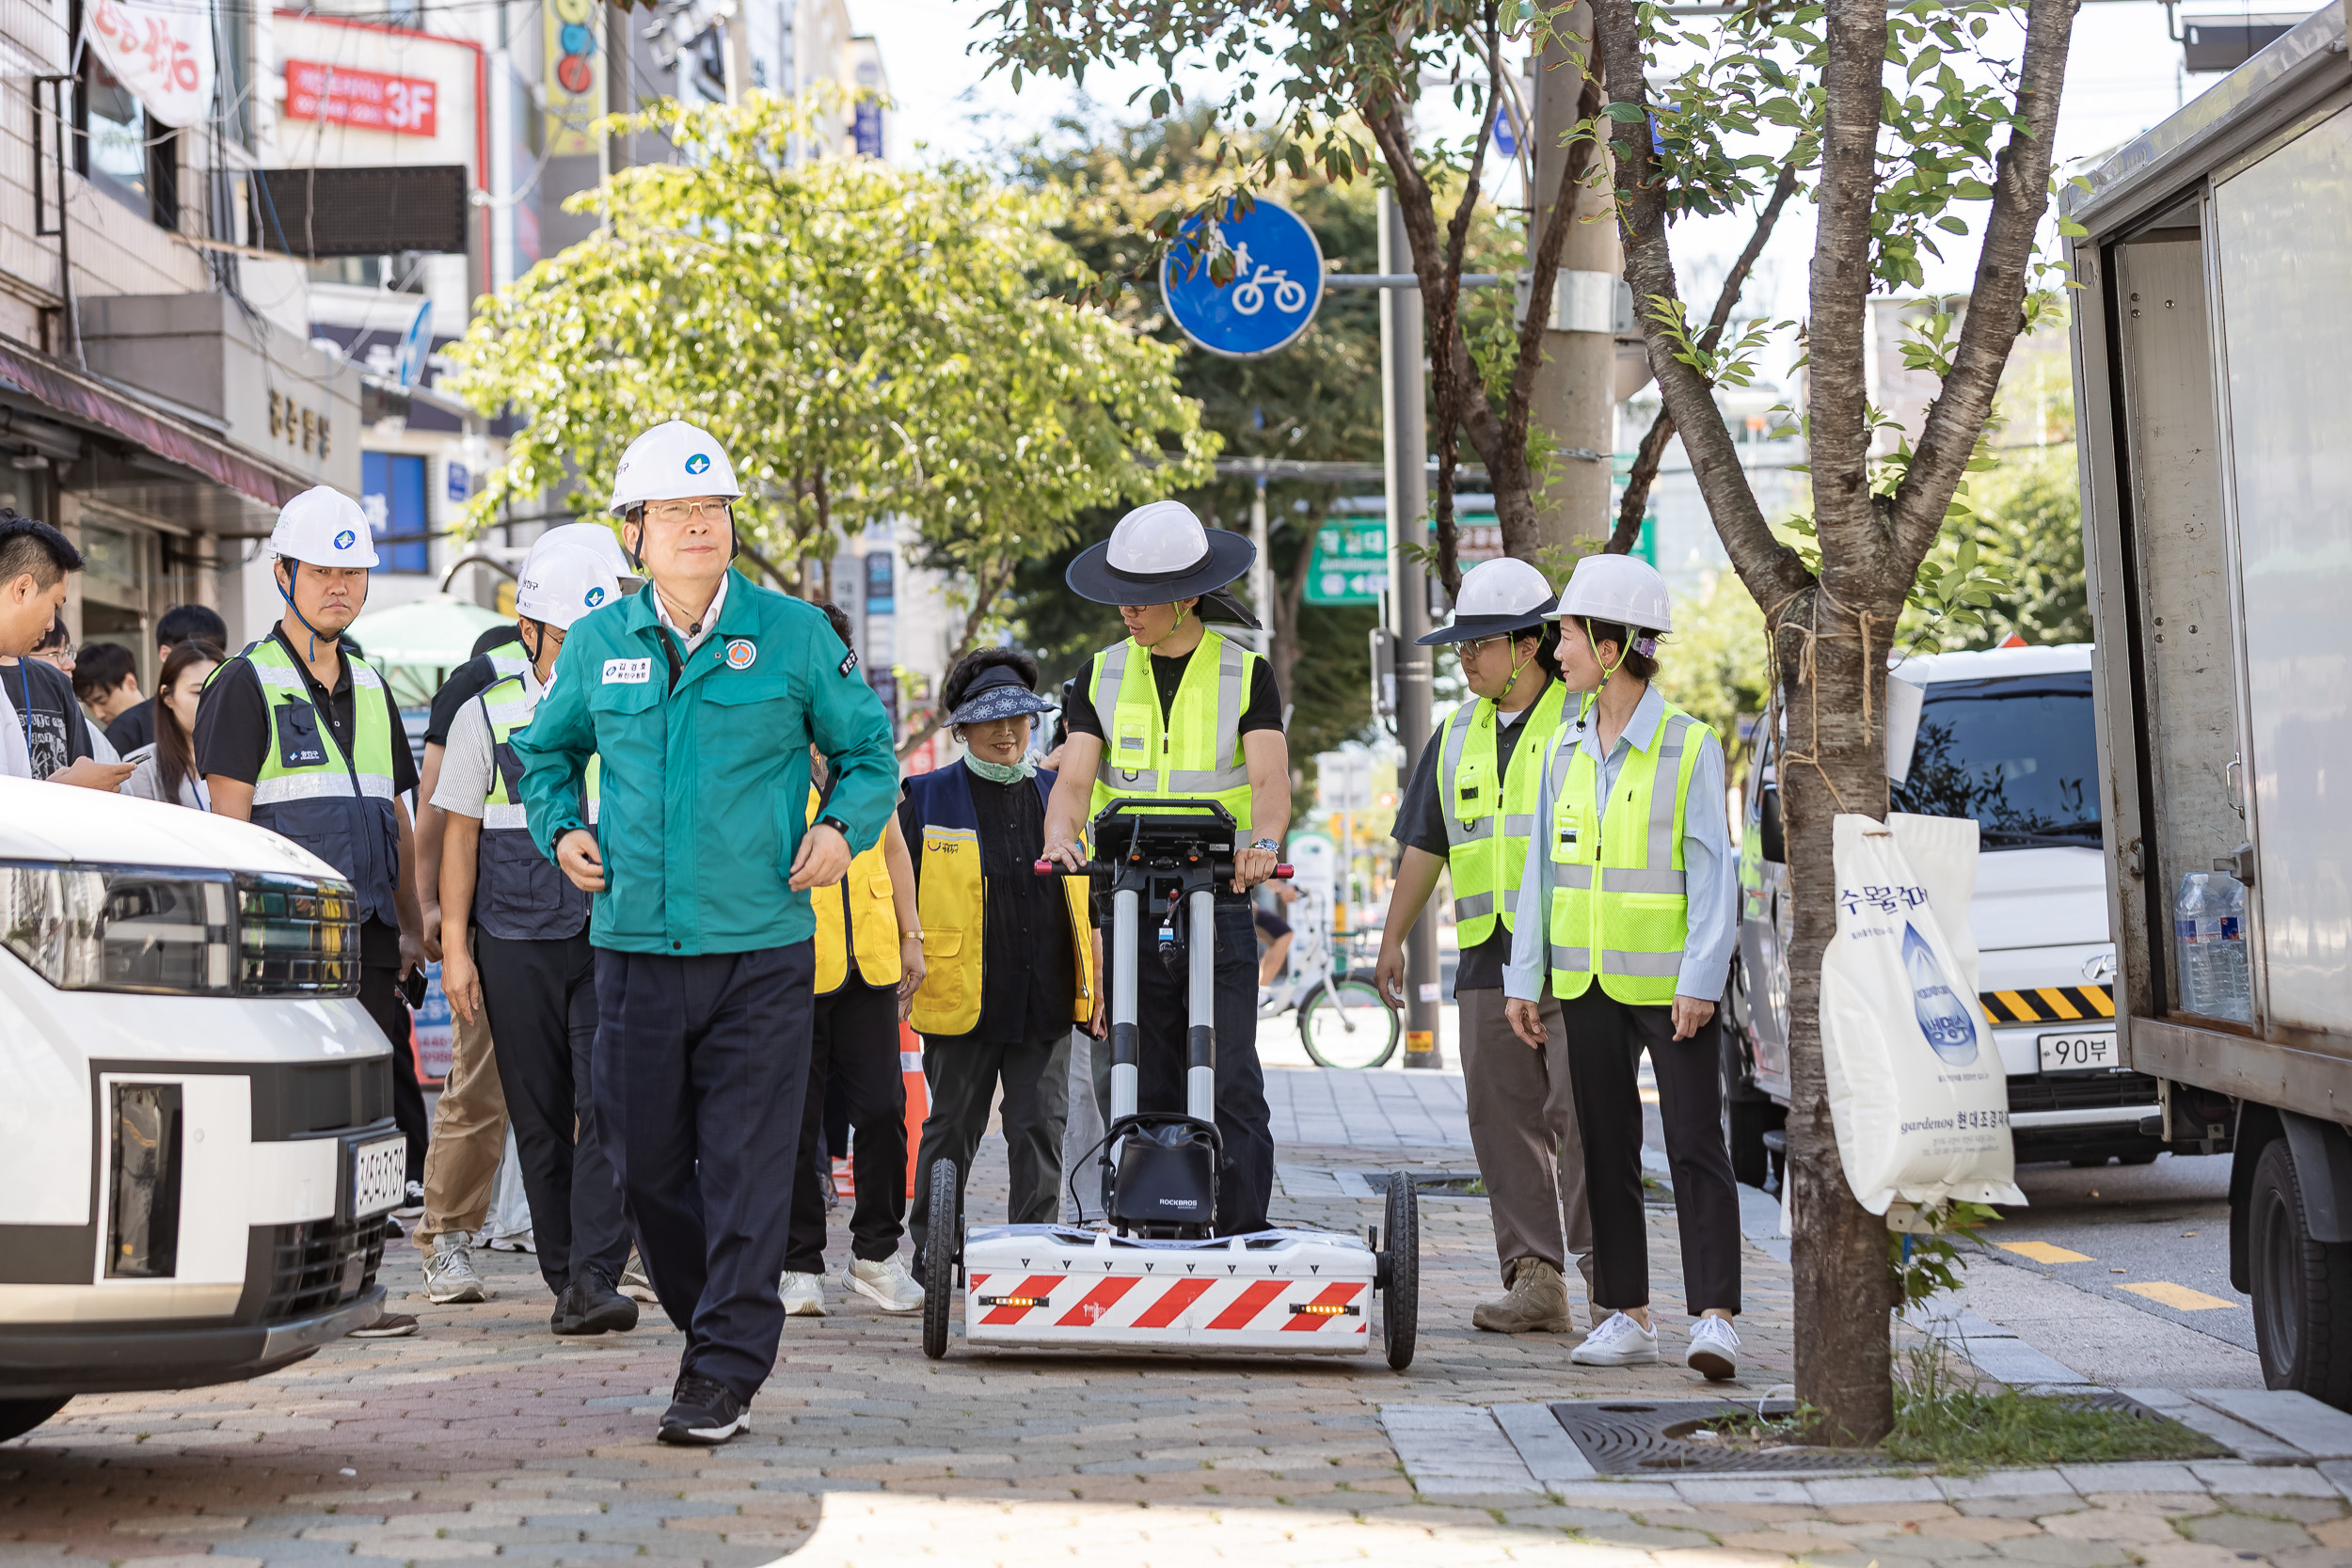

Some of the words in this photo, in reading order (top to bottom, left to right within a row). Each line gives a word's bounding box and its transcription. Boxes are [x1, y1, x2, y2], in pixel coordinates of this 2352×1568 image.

[385, 81, 433, 129] 3F
[2056, 1039, 2106, 1065] 90부
[1900, 1117, 1954, 1134] garden09
[1159, 1198, 1198, 1207] ROCKBROS
